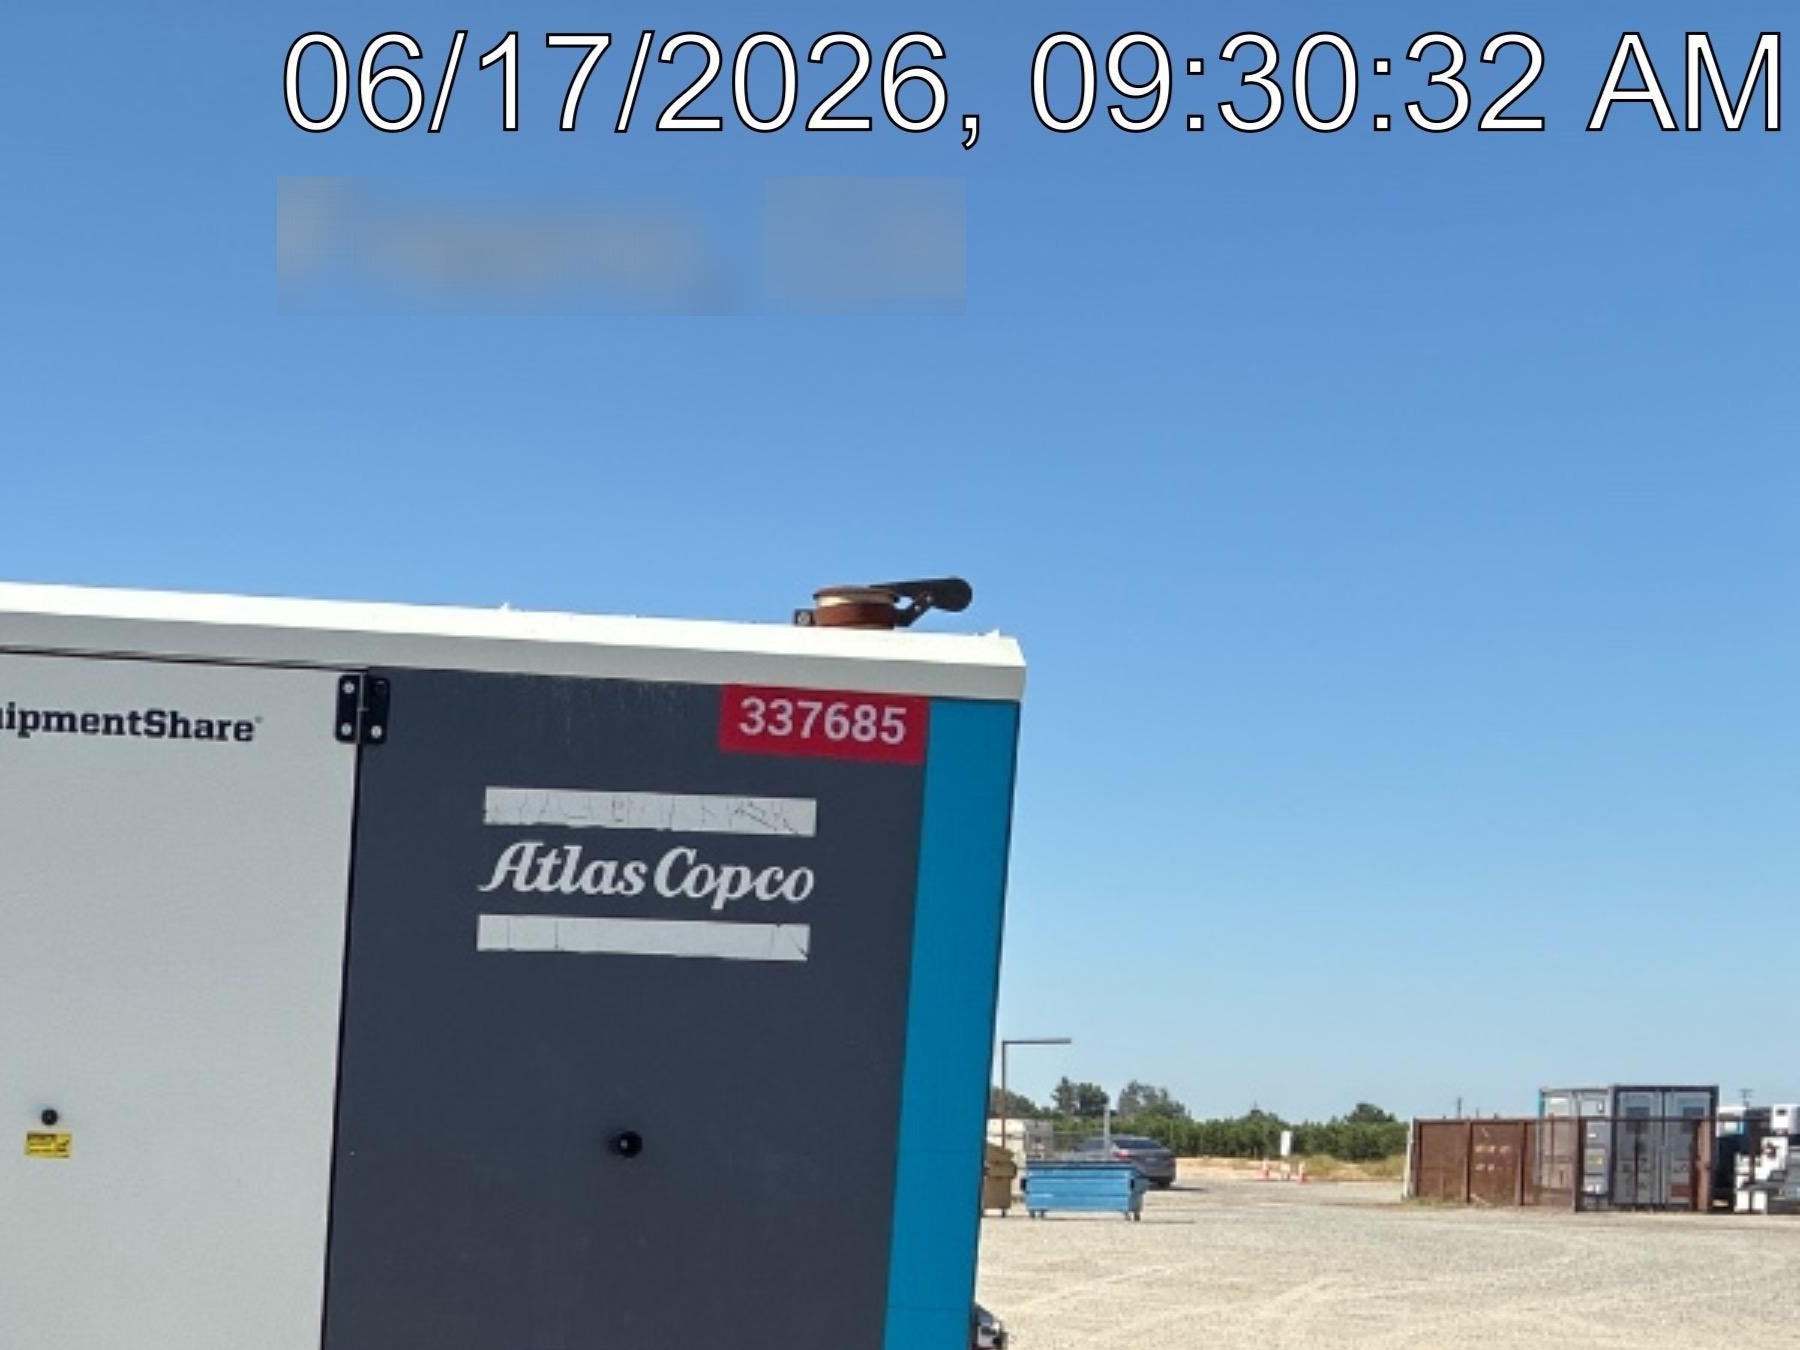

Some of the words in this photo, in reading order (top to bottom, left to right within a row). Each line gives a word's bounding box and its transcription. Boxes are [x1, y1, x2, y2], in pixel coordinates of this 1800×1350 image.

[738, 696, 907, 745] 337685
[478, 840, 647, 896] Atlas
[653, 845, 814, 910] Copco
